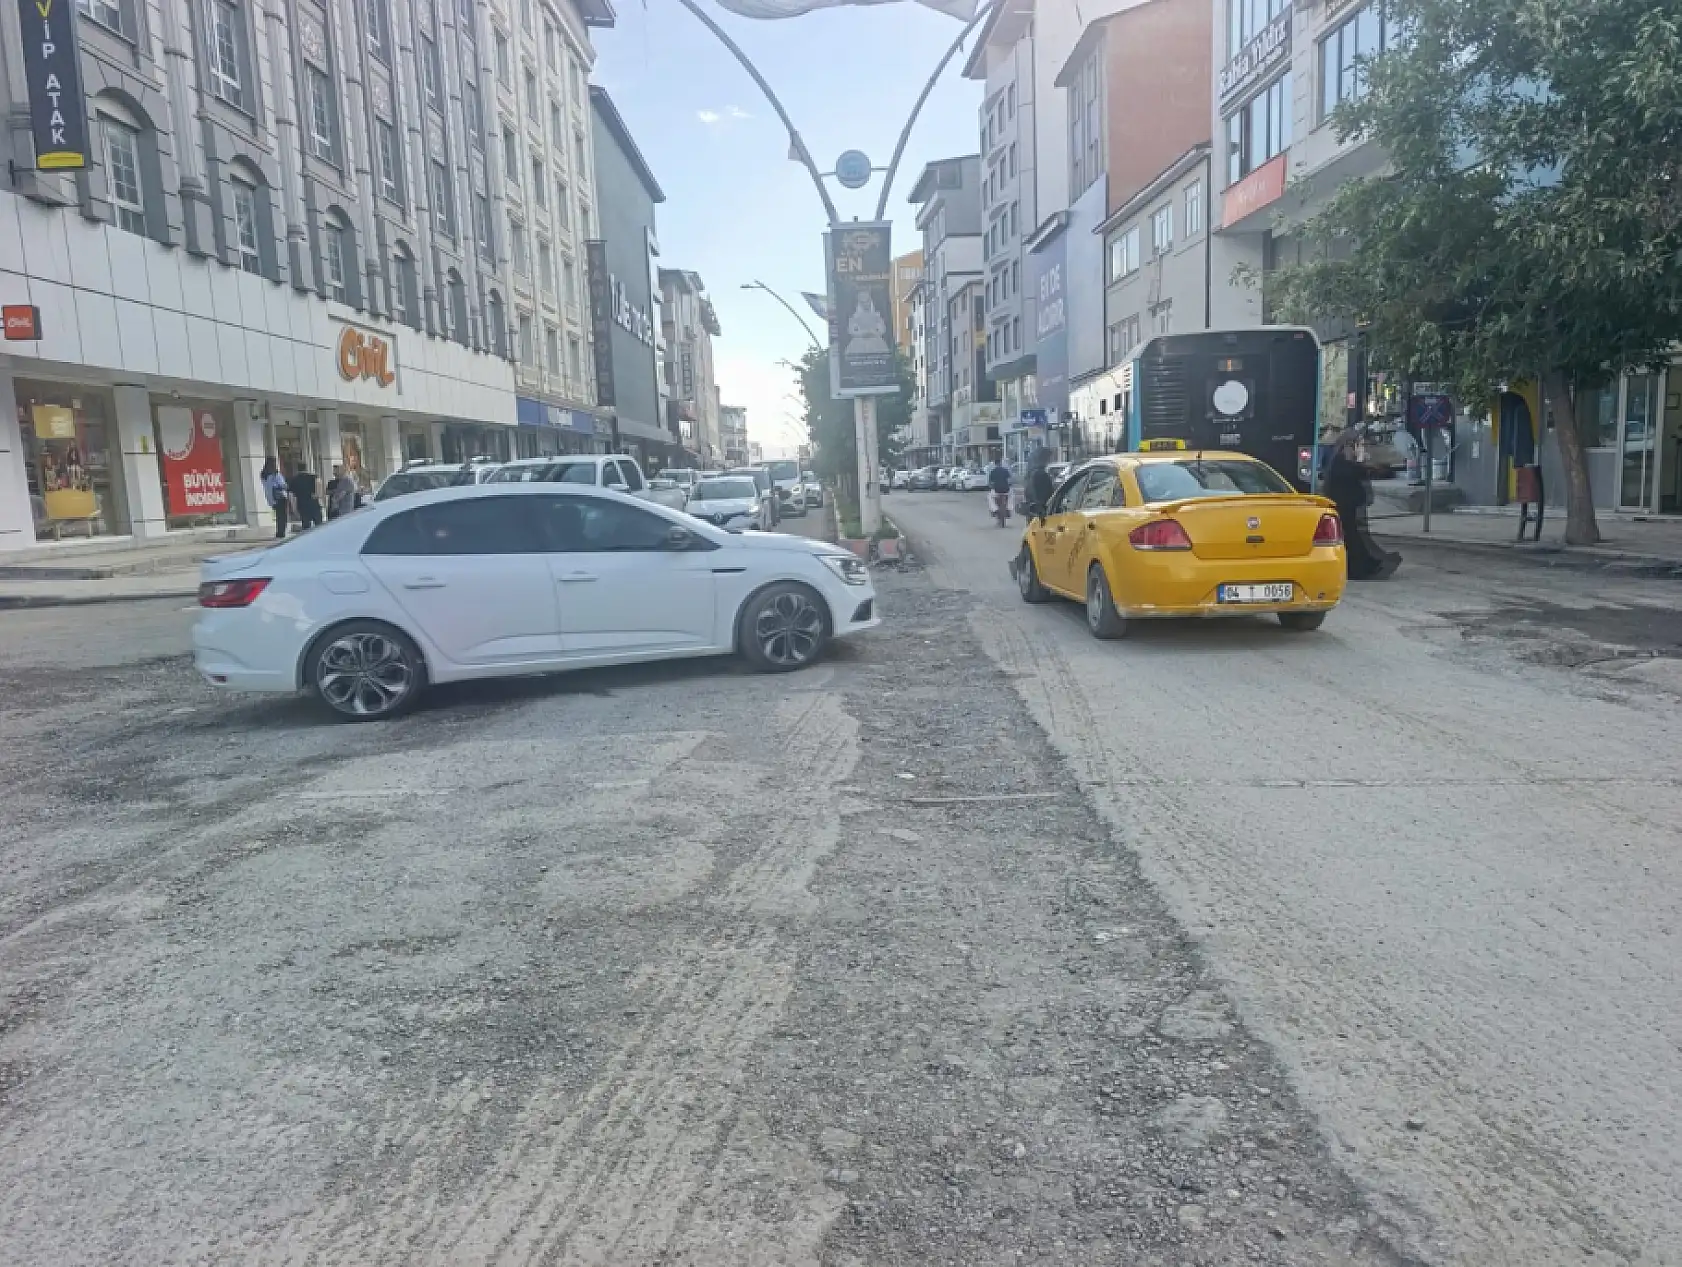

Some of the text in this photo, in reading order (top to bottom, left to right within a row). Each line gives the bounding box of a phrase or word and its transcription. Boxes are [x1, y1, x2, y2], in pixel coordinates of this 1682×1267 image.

[46, 73, 66, 145] ATAK
[836, 257, 863, 273] EN
[183, 468, 223, 489] BÜYÜK
[185, 486, 226, 507] İNDİRİM
[1263, 583, 1292, 598] 0056
